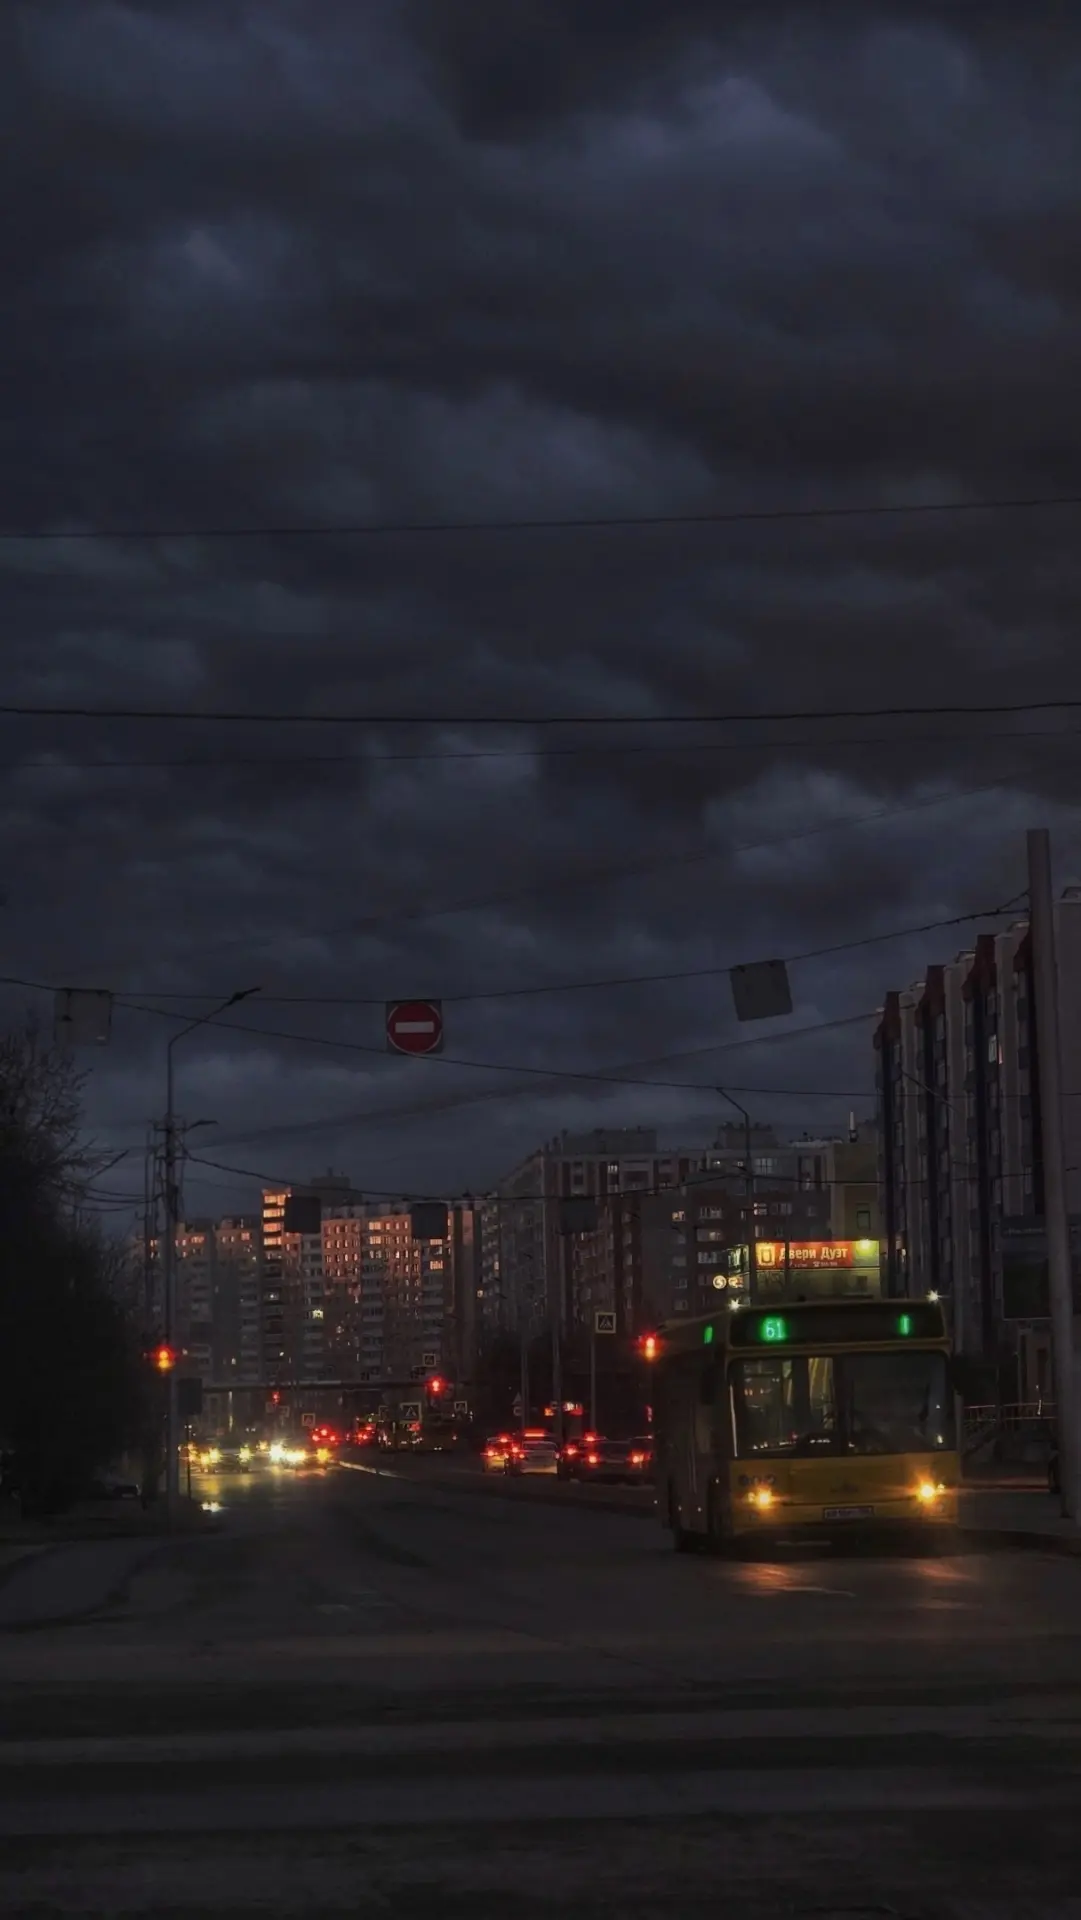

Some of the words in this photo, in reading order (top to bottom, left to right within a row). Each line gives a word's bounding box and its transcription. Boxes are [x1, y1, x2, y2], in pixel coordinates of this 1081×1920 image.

[779, 1247, 816, 1260] Двери
[820, 1246, 849, 1260] Дуэт
[764, 1319, 786, 1341] 61
